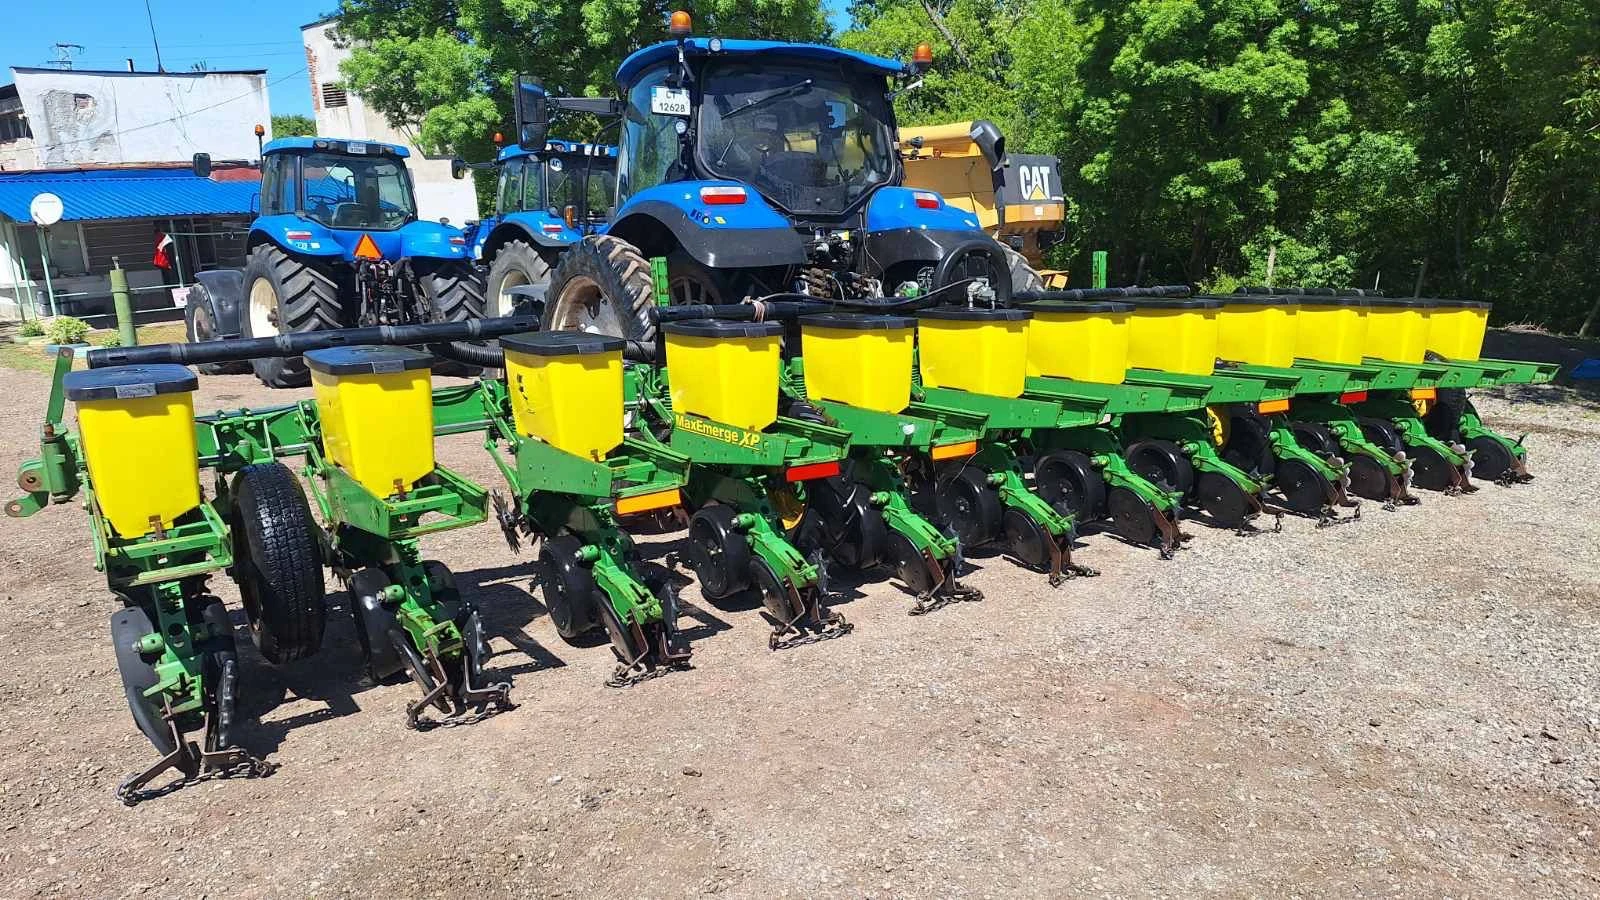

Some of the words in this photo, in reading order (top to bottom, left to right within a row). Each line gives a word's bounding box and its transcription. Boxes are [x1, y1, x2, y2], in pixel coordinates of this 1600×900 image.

[659, 102, 686, 112] 12628
[1019, 165, 1050, 200] CAT
[675, 414, 739, 442] MaxEmerge
[739, 430, 761, 446] XP
